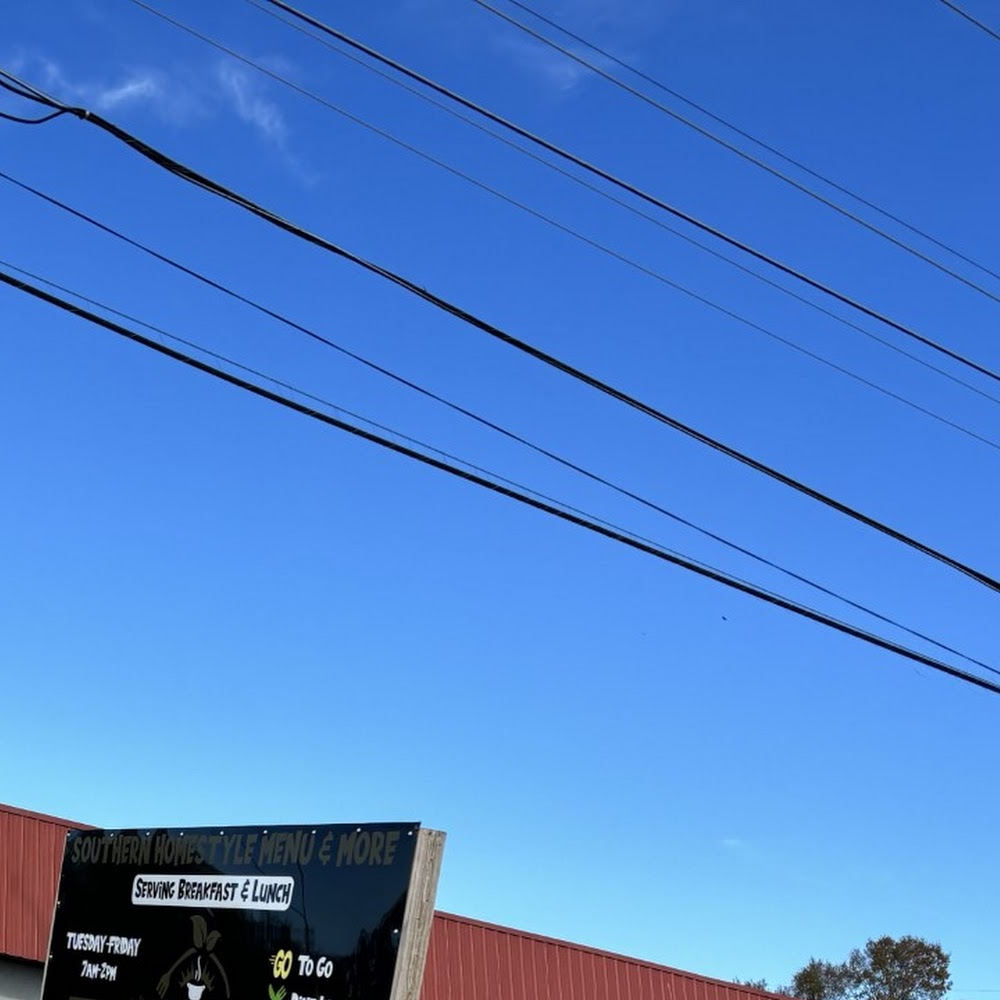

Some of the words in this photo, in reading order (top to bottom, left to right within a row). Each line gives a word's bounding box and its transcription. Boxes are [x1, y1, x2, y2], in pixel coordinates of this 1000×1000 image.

[71, 834, 150, 866] SOUTHERN
[153, 832, 258, 867] HOMESTYLE
[258, 830, 316, 867] MENU
[318, 831, 333, 866] &
[336, 830, 400, 867] MORE
[134, 878, 175, 900] SERVING
[177, 879, 239, 902] BREAKFAST
[240, 879, 250, 902] &
[251, 879, 292, 904] LUNCH
[272, 949, 293, 980] GO
[298, 955, 314, 977] TO
[316, 956, 333, 978] GO
